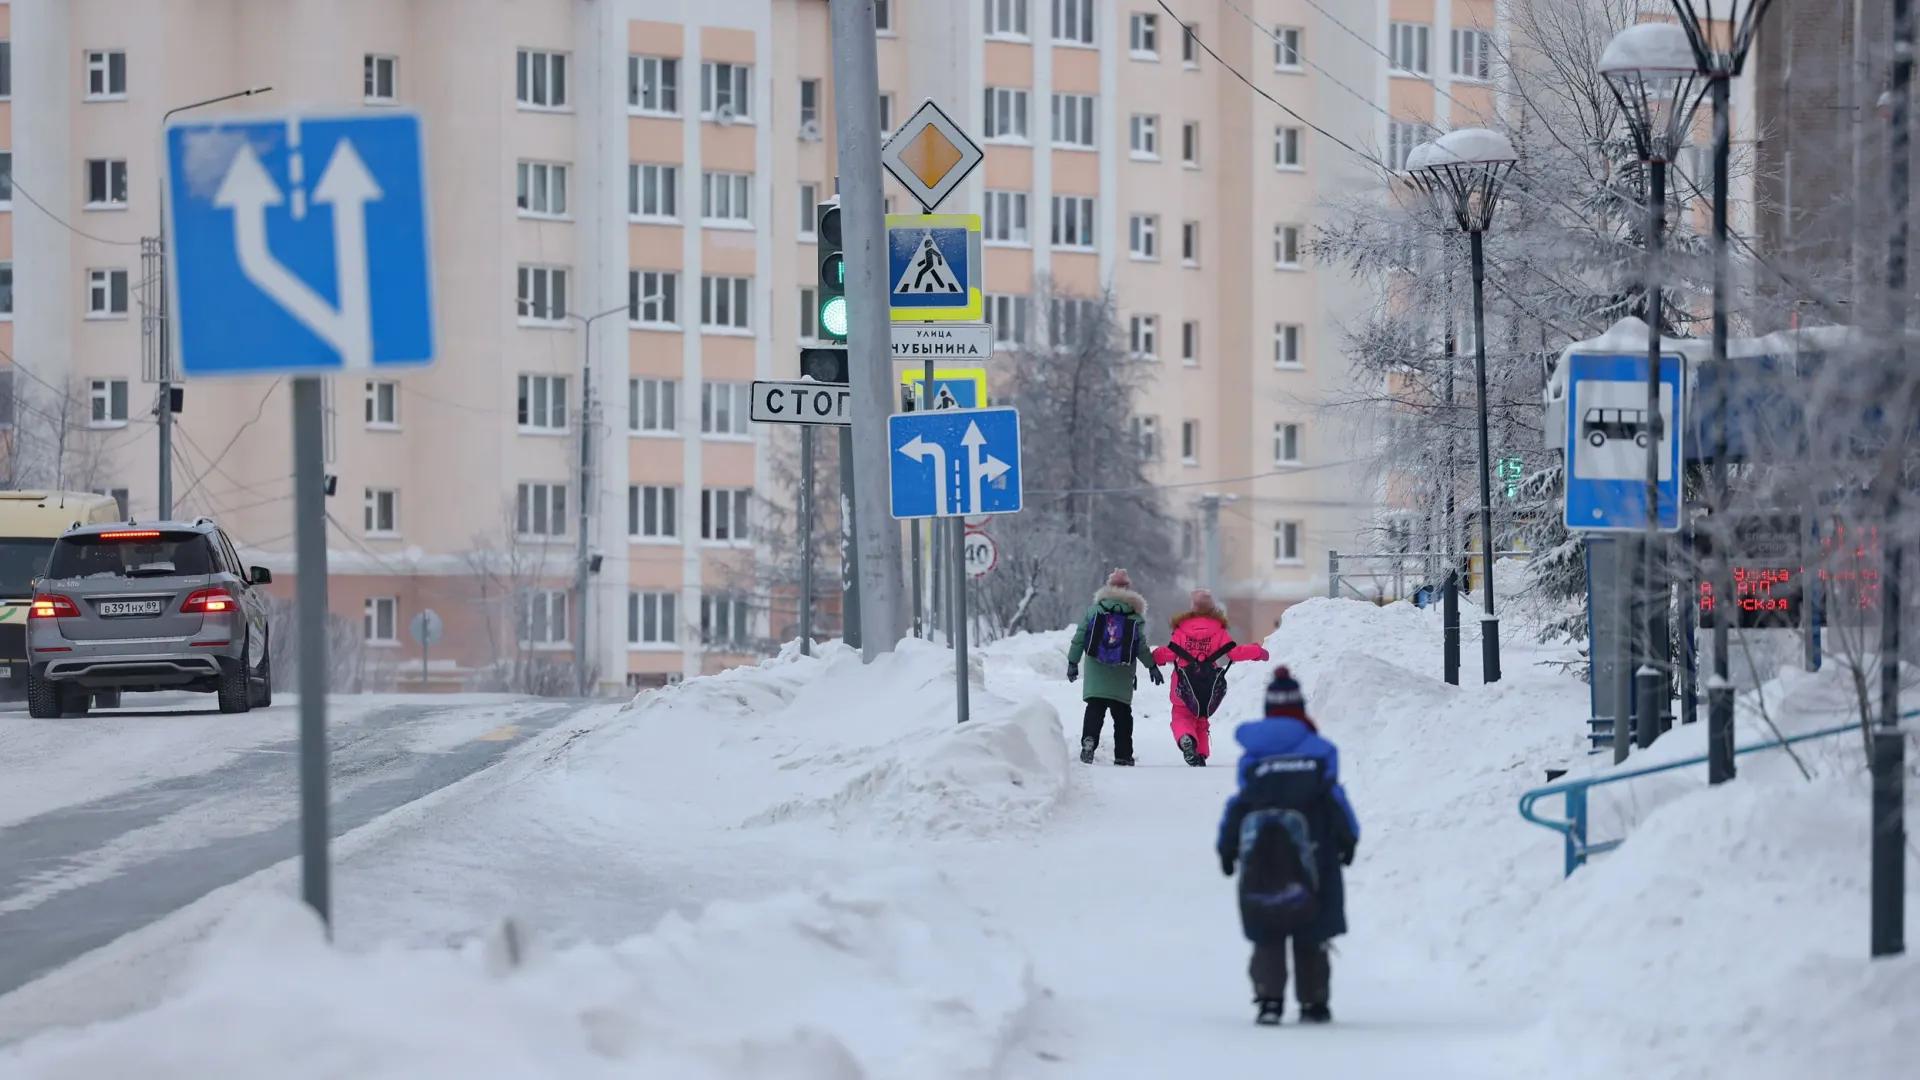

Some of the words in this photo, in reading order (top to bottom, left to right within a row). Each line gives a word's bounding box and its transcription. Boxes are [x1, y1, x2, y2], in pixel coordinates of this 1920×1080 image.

[916, 330, 953, 338] УЛИЦА
[891, 343, 978, 354] ЧУБЫНИНА
[965, 544, 988, 565] 40
